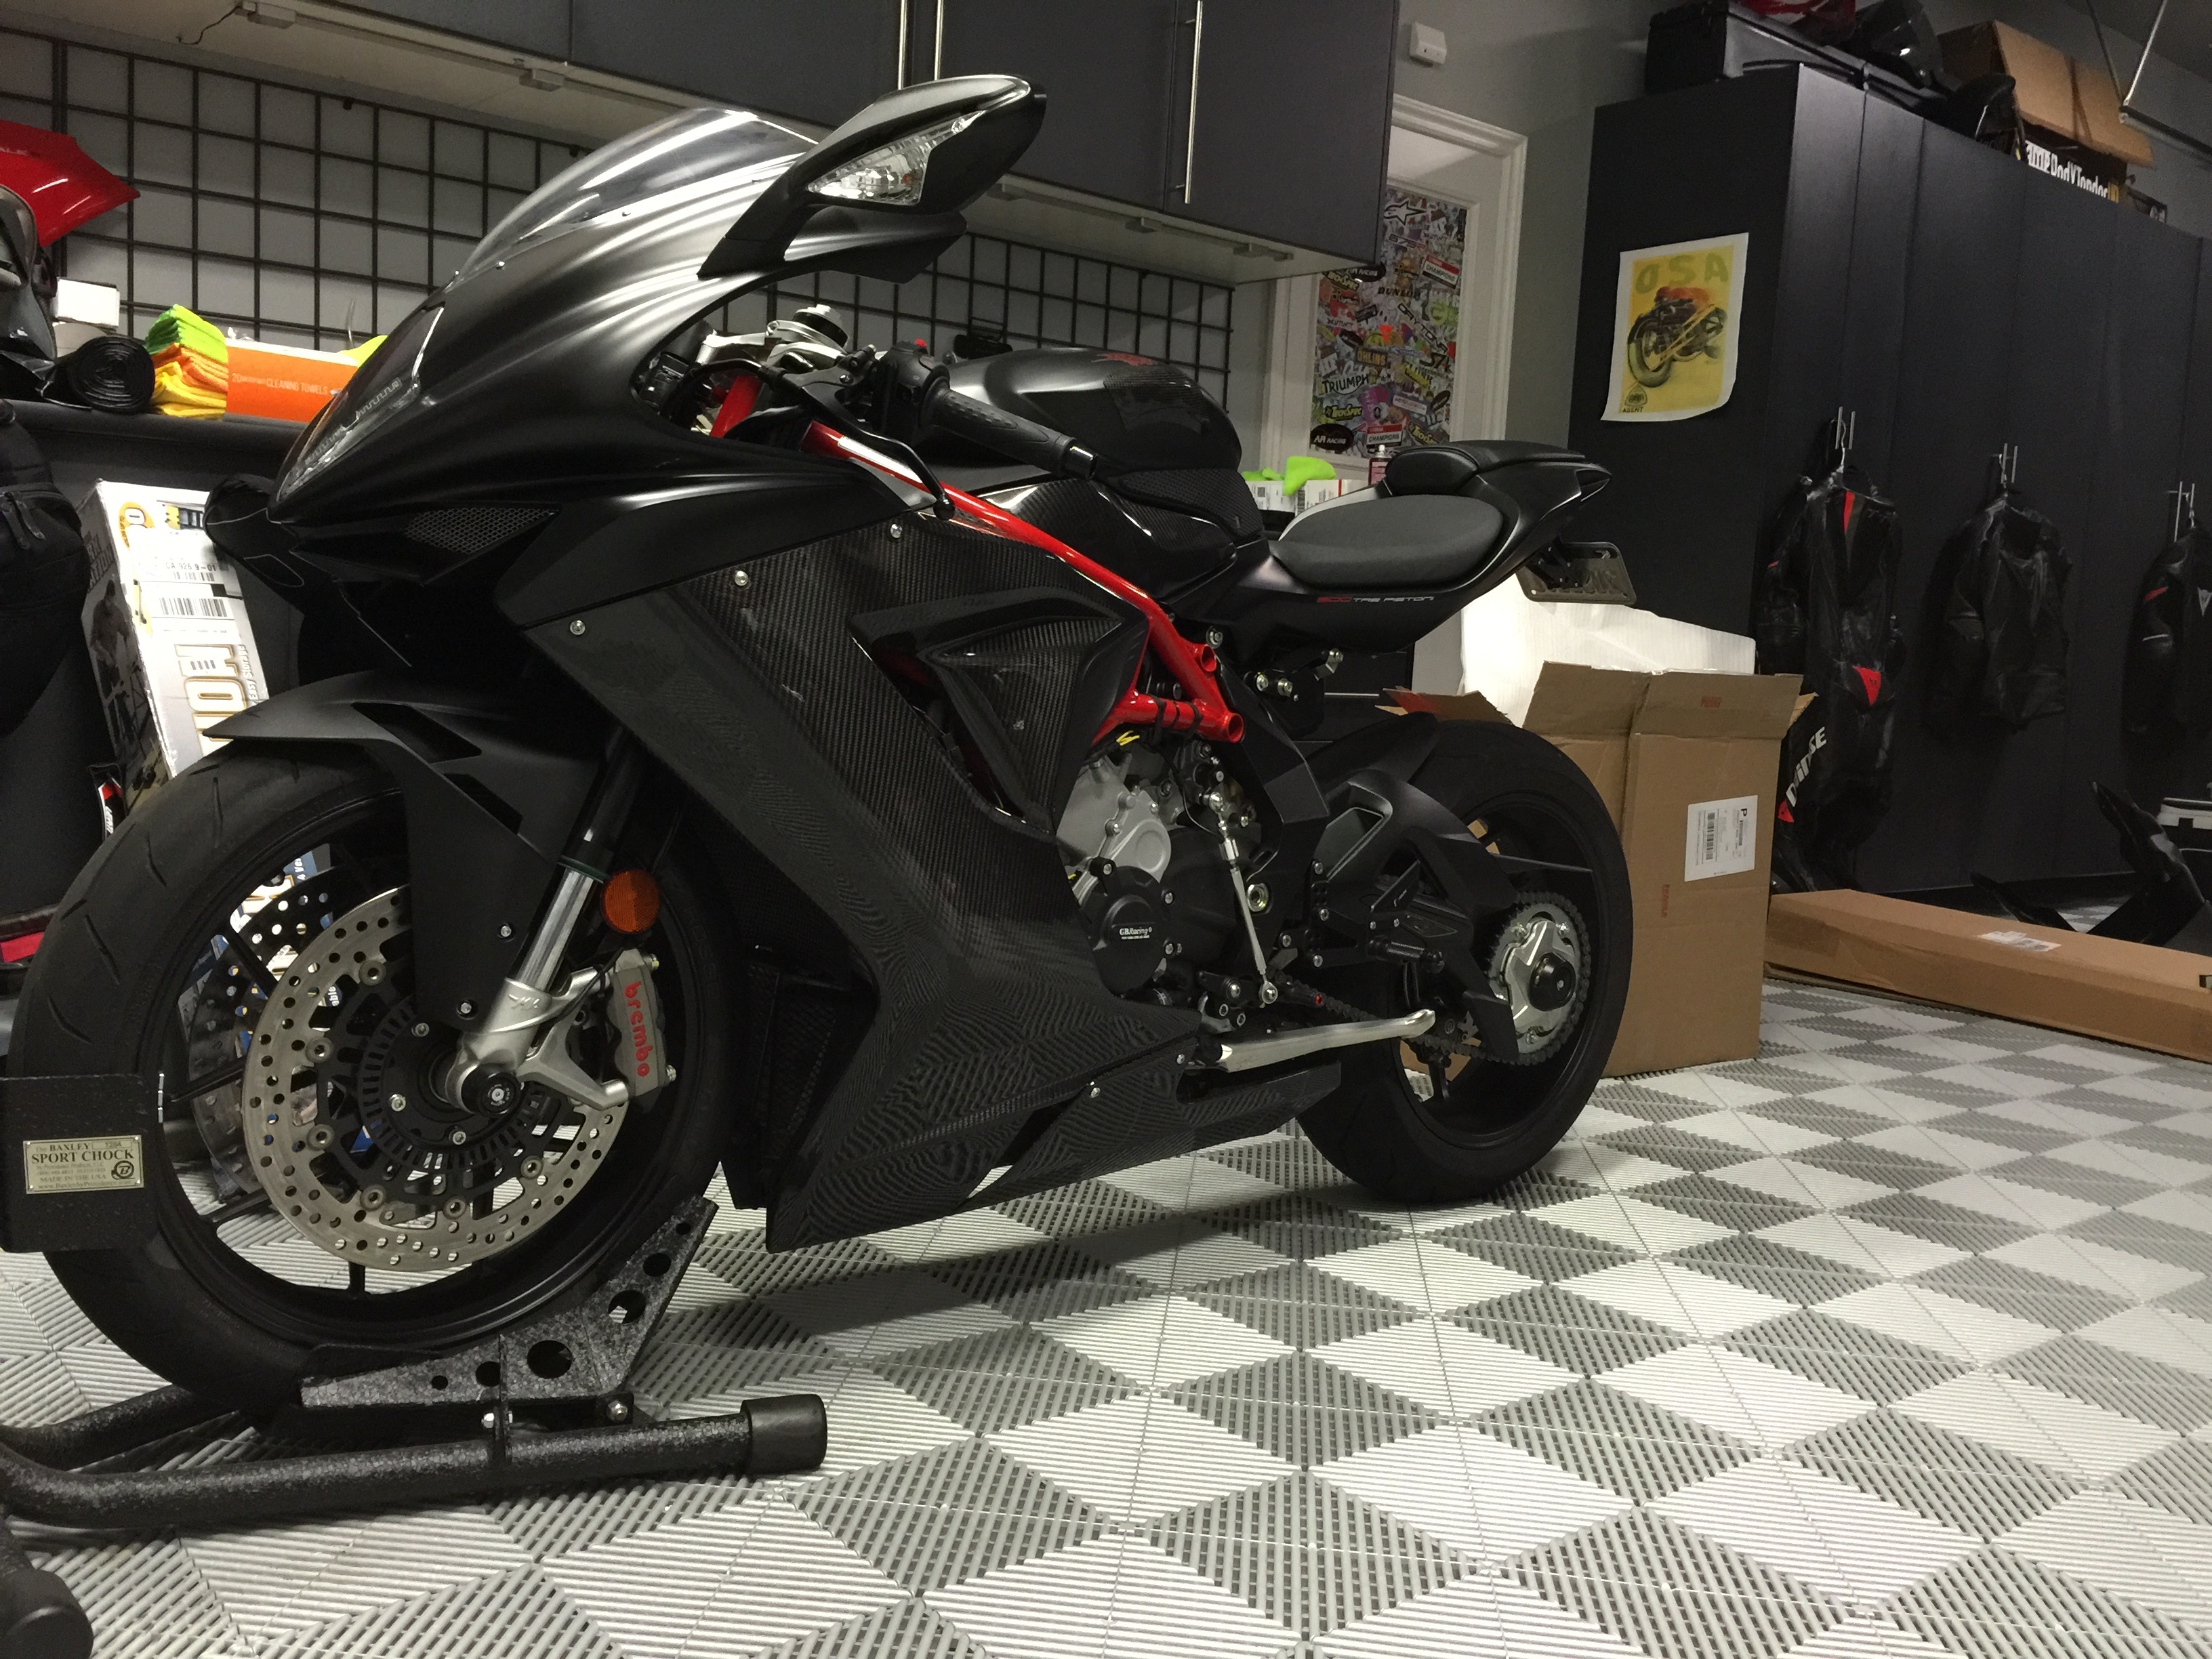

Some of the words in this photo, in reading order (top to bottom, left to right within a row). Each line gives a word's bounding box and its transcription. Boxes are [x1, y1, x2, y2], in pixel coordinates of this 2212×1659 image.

[266, 377, 300, 391] CLEANING
[300, 382, 328, 394] TOWELS
[1322, 373, 1369, 394] TRIUMPH
[238, 644, 254, 678] Storage
[248, 680, 259, 701] Easy
[624, 981, 653, 1077] brembo
[31, 1152, 78, 1164] SPORT
[81, 1149, 134, 1162] CHOCK
[49, 1143, 89, 1151] BAXLEY
